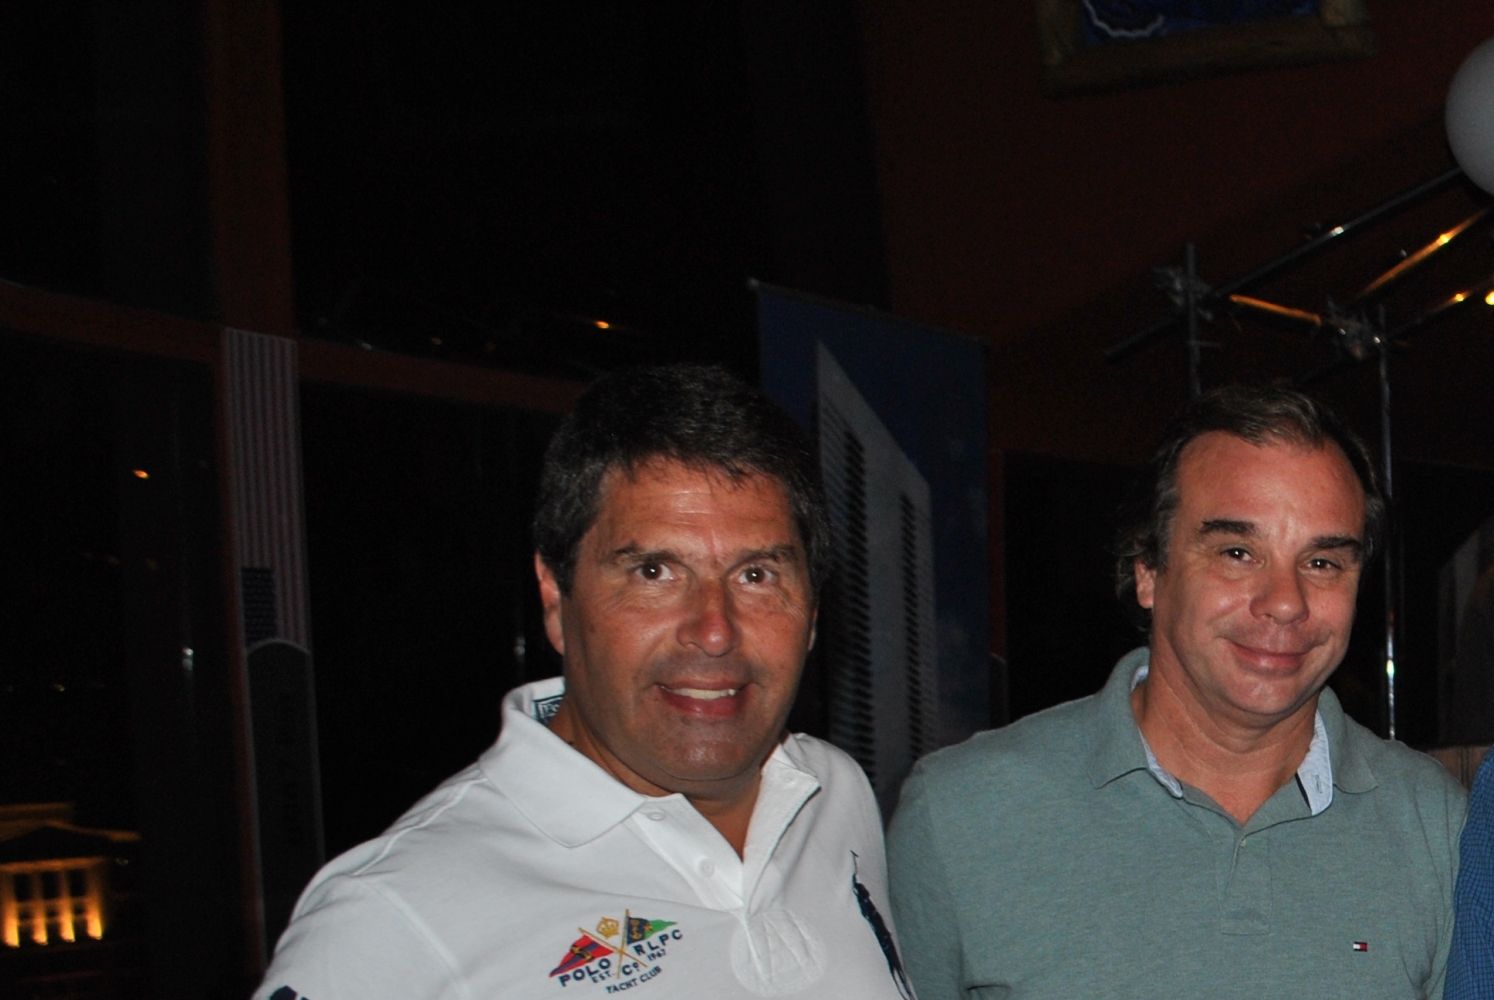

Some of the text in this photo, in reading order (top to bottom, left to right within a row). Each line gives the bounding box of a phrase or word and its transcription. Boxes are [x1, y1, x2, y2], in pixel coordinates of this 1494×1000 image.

[558, 958, 611, 987] POLO
[605, 965, 662, 994] YACHT CLUB
